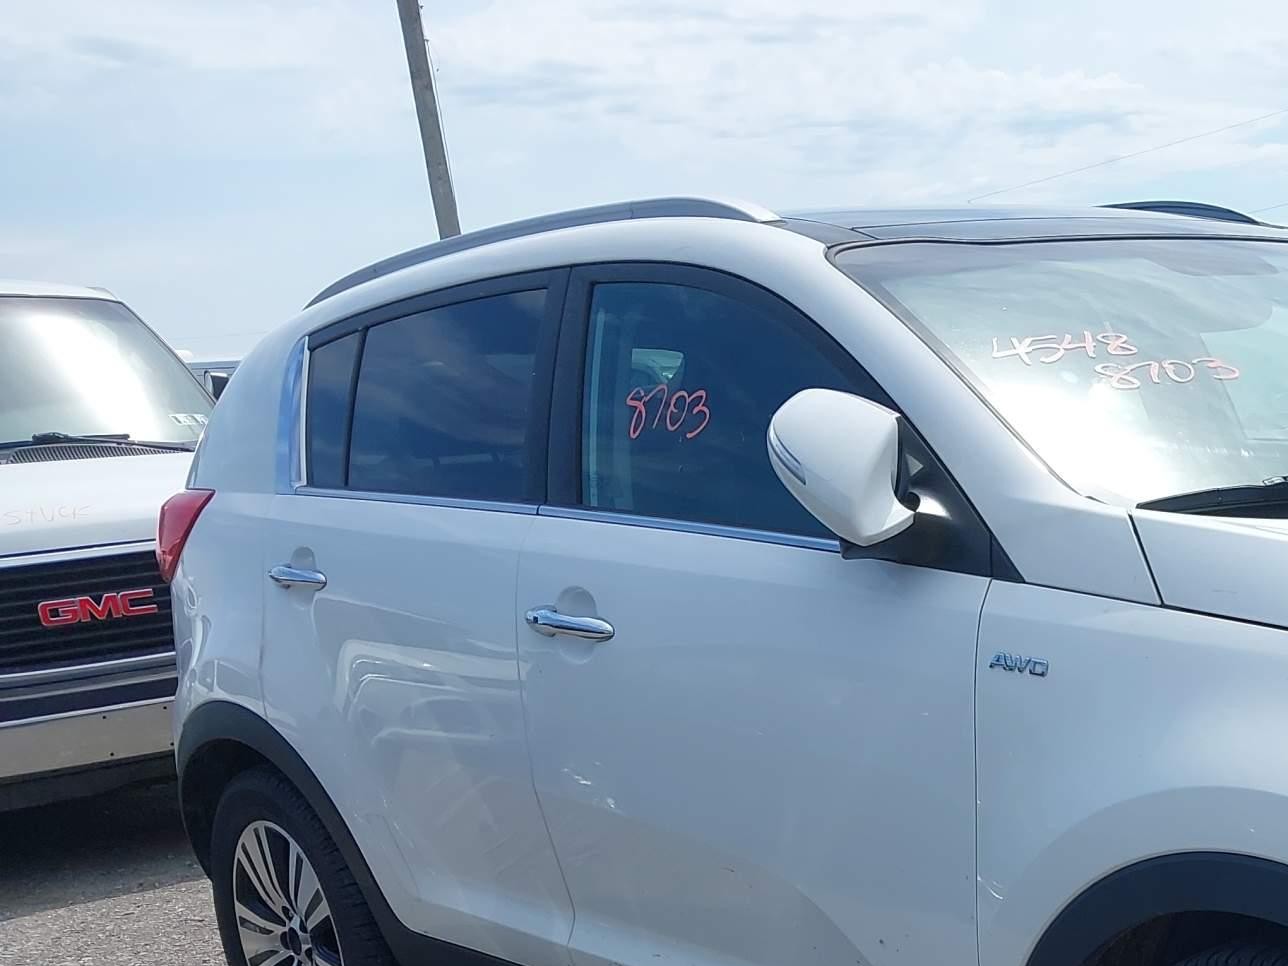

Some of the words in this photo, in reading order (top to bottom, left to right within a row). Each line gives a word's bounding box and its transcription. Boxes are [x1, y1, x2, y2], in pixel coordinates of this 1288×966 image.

[992, 331, 1138, 365] 4548
[1095, 357, 1240, 390] 8703
[626, 384, 710, 439] 8703
[38, 588, 158, 626] GMC
[989, 652, 1049, 677] AWD
